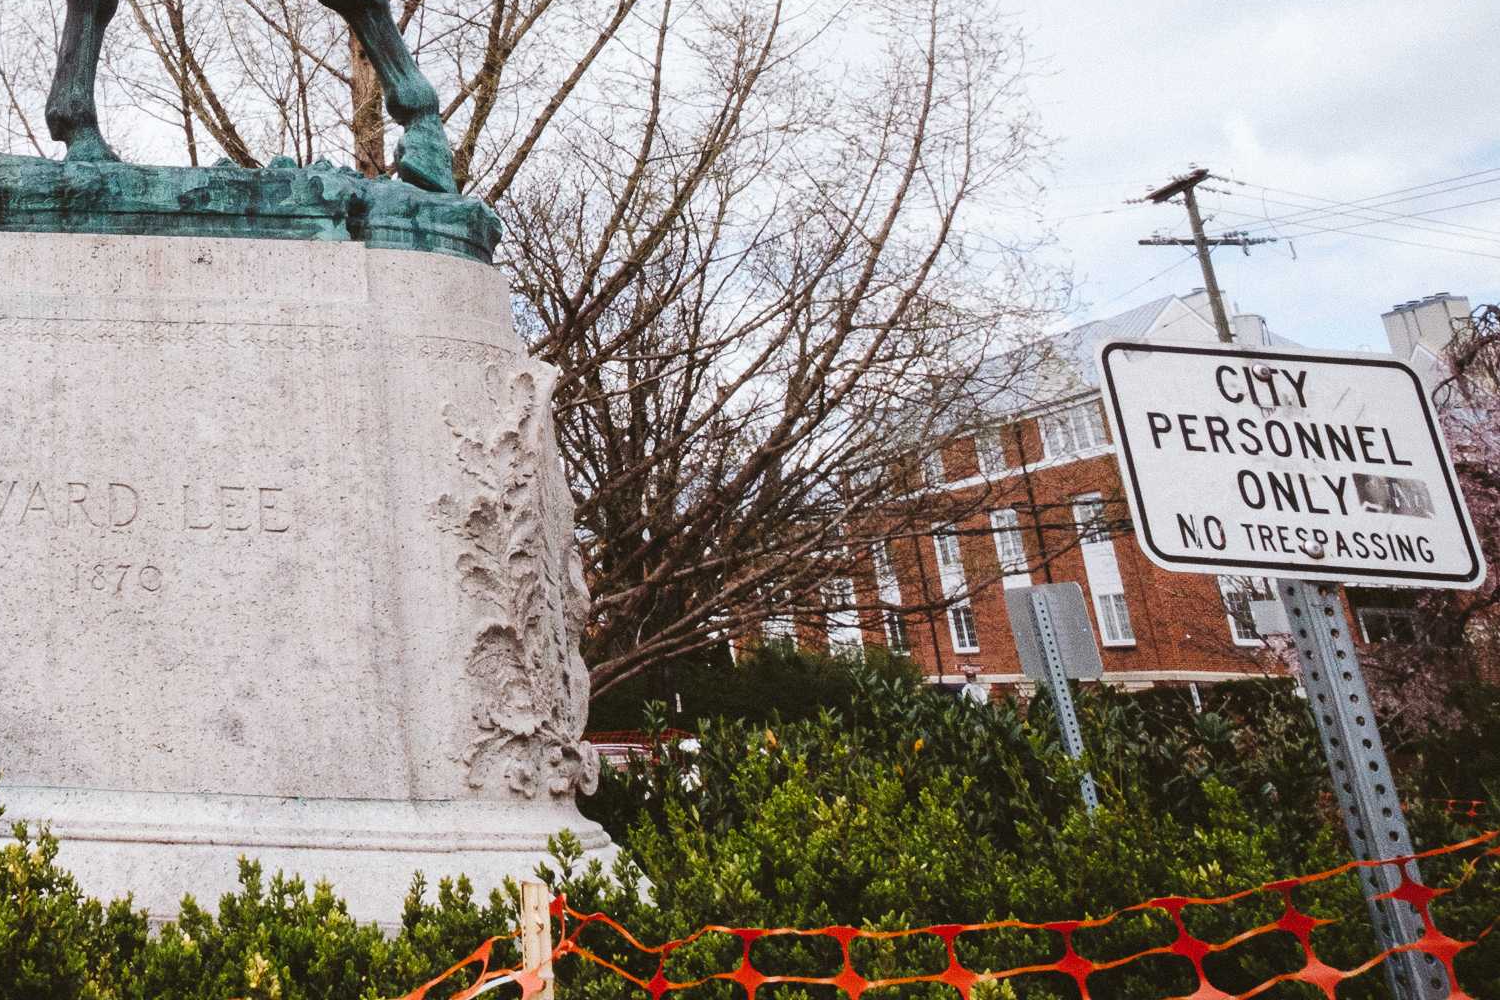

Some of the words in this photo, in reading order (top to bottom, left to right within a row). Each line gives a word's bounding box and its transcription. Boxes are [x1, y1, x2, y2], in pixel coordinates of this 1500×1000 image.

[1215, 365, 1308, 408] CITY
[1146, 411, 1413, 467] PERSONNEL
[181, 484, 291, 534] LEE
[1236, 469, 1349, 516] ONLY
[1176, 513, 1227, 551] NO
[1240, 523, 1436, 564] TRESPASSING
[72, 563, 163, 596] 1870
